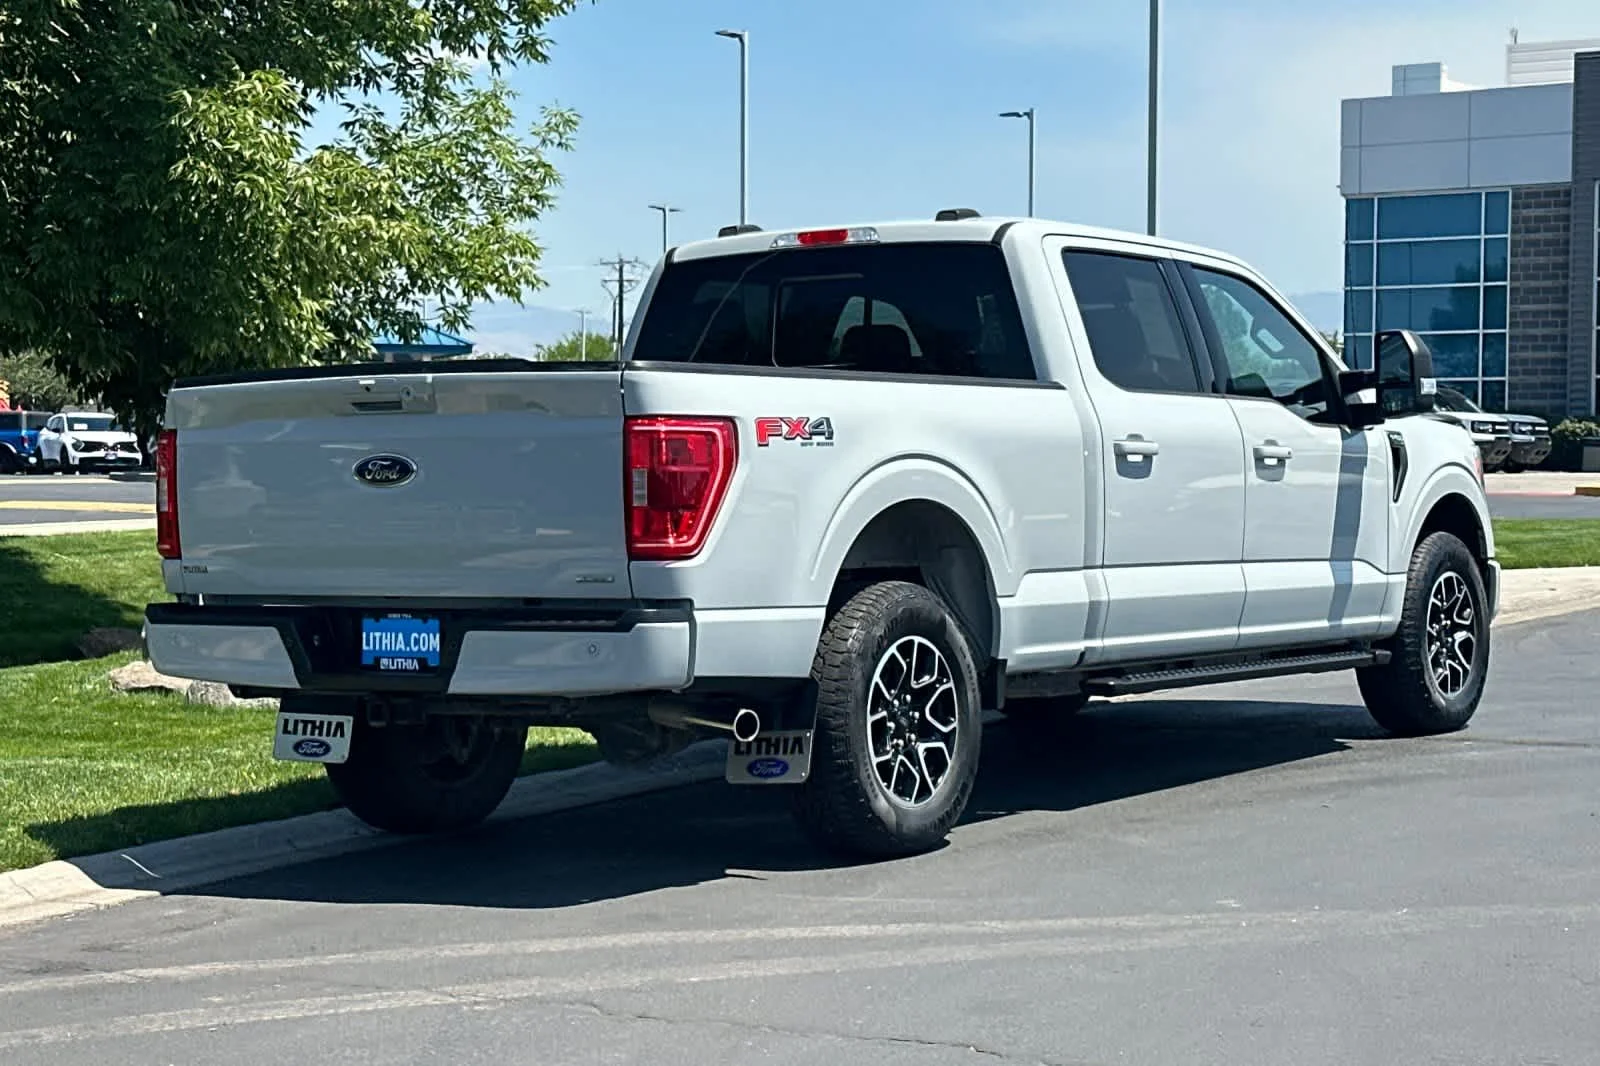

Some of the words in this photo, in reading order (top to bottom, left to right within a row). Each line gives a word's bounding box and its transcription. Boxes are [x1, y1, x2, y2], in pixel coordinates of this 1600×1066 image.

[755, 417, 834, 447] FX4
[362, 631, 440, 652] LITHIA.COM
[388, 658, 419, 670] LITHIA
[282, 718, 345, 738] LITHIA
